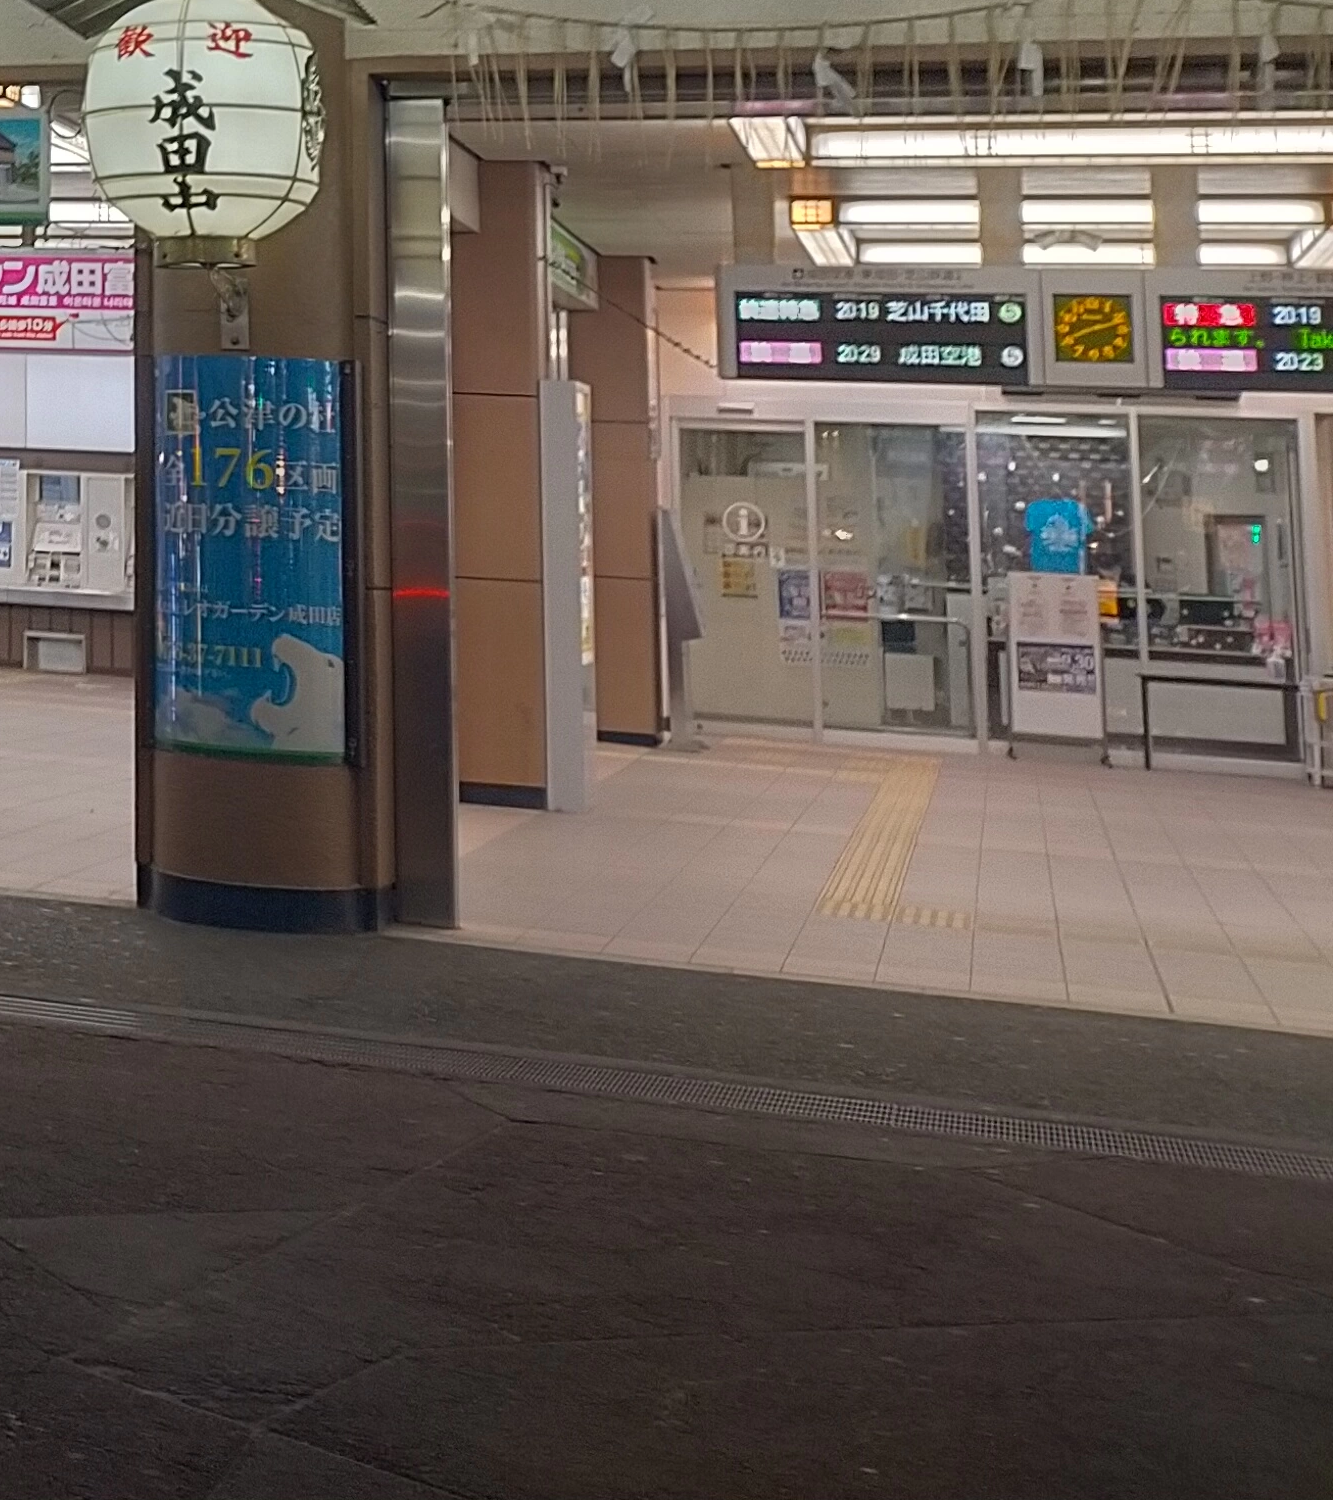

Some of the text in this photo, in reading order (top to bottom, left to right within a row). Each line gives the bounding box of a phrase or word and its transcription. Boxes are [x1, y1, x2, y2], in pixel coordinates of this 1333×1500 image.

[149, 68, 218, 212] 成田山
[835, 301, 880, 321] 2019
[1272, 306, 1322, 326] 2019
[1274, 351, 1325, 372] 2023
